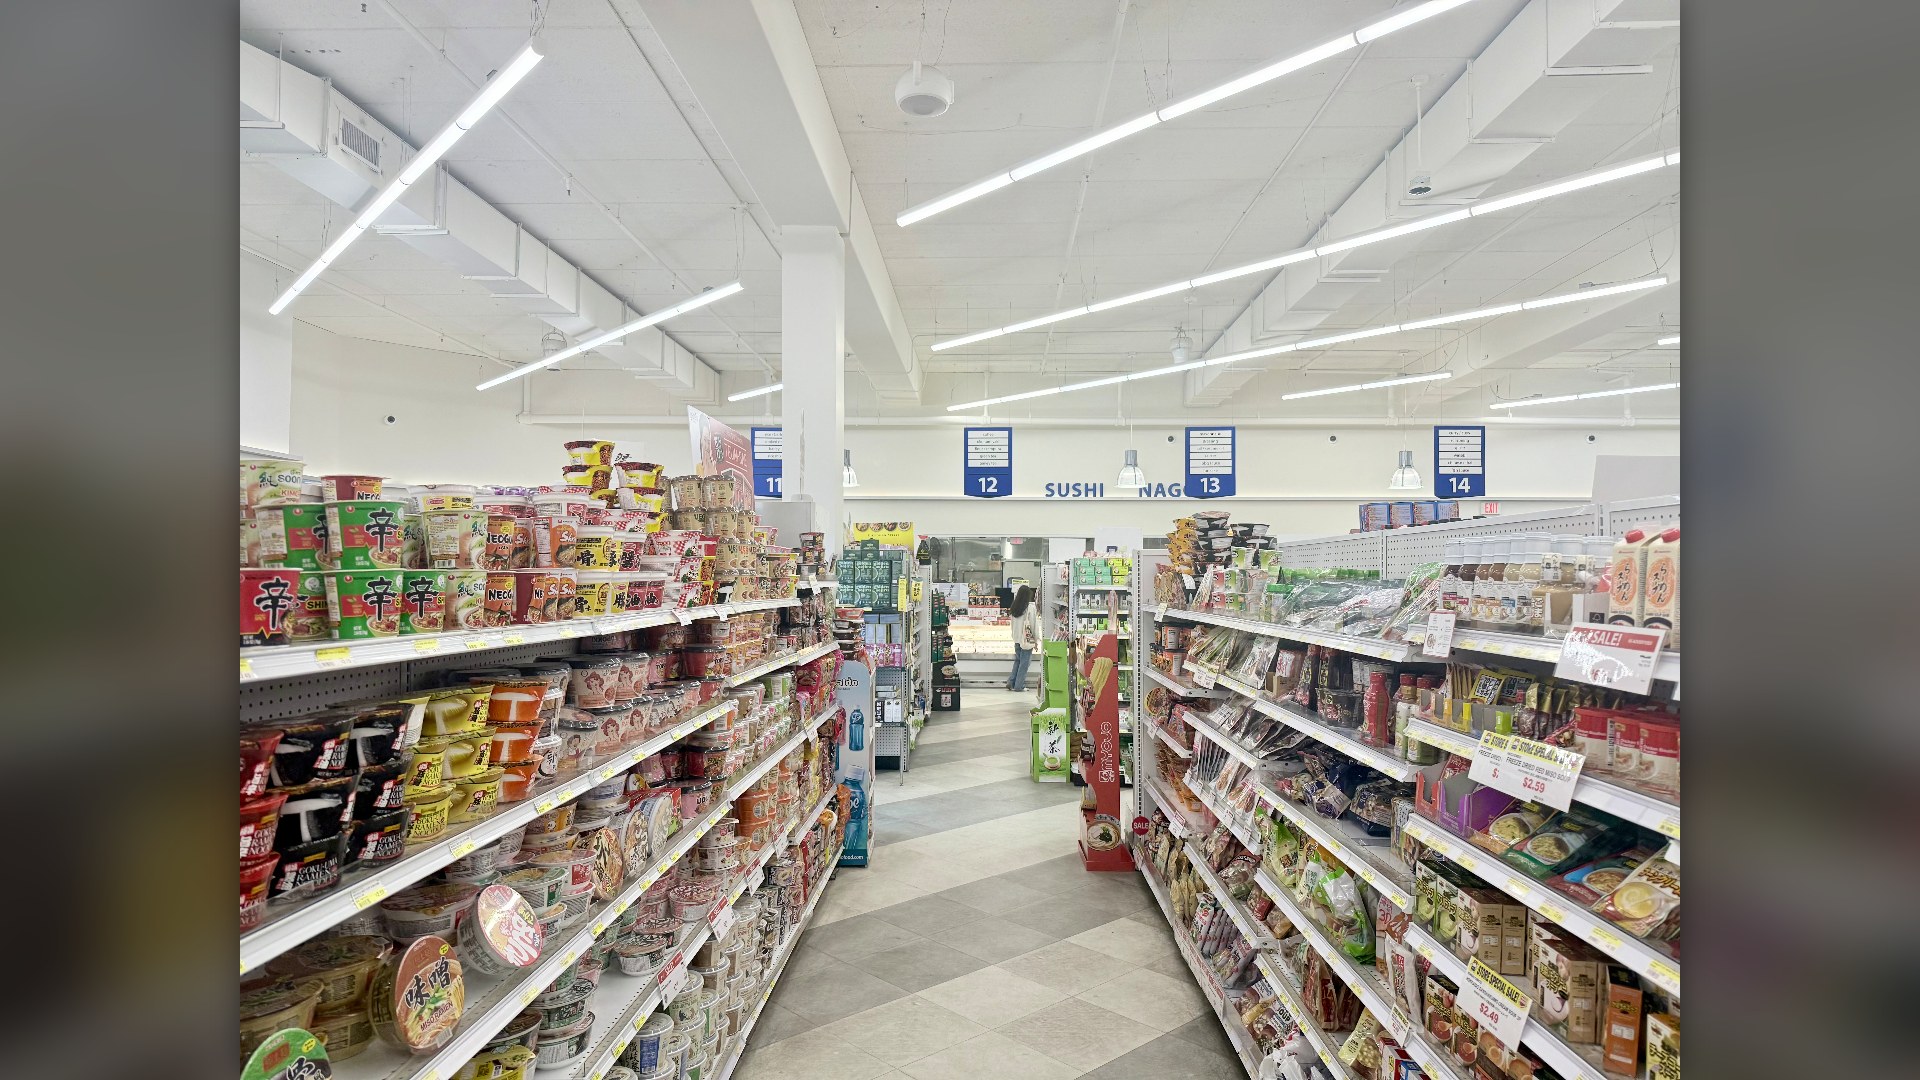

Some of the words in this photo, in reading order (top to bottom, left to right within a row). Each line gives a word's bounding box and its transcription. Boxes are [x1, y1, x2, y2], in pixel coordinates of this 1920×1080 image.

[978, 476, 998, 492] 12
[1045, 482, 1104, 498] SUSHI
[1138, 482, 1186, 498] NAG
[1200, 477, 1220, 493] 13
[1448, 477, 1471, 493] 14
[1484, 502, 1498, 514] EXIT
[254, 576, 294, 630] 辛
[362, 576, 398, 621] 辛
[406, 576, 440, 618] 辛
[1590, 632, 1622, 646] SALE!
[837, 676, 858, 686] aldo
[1522, 761, 1535, 771] DRIED
[1546, 769, 1557, 779] MISO
[1522, 777, 1546, 794] $2.59
[1476, 966, 1490, 983] STORE
[1489, 972, 1507, 994] SPECIAL
[1506, 986, 1520, 1003] SALE!
[420, 1016, 435, 1031] MISO
[434, 1001, 454, 1020] RAMEN
[1480, 1002, 1499, 1024] $2.49
